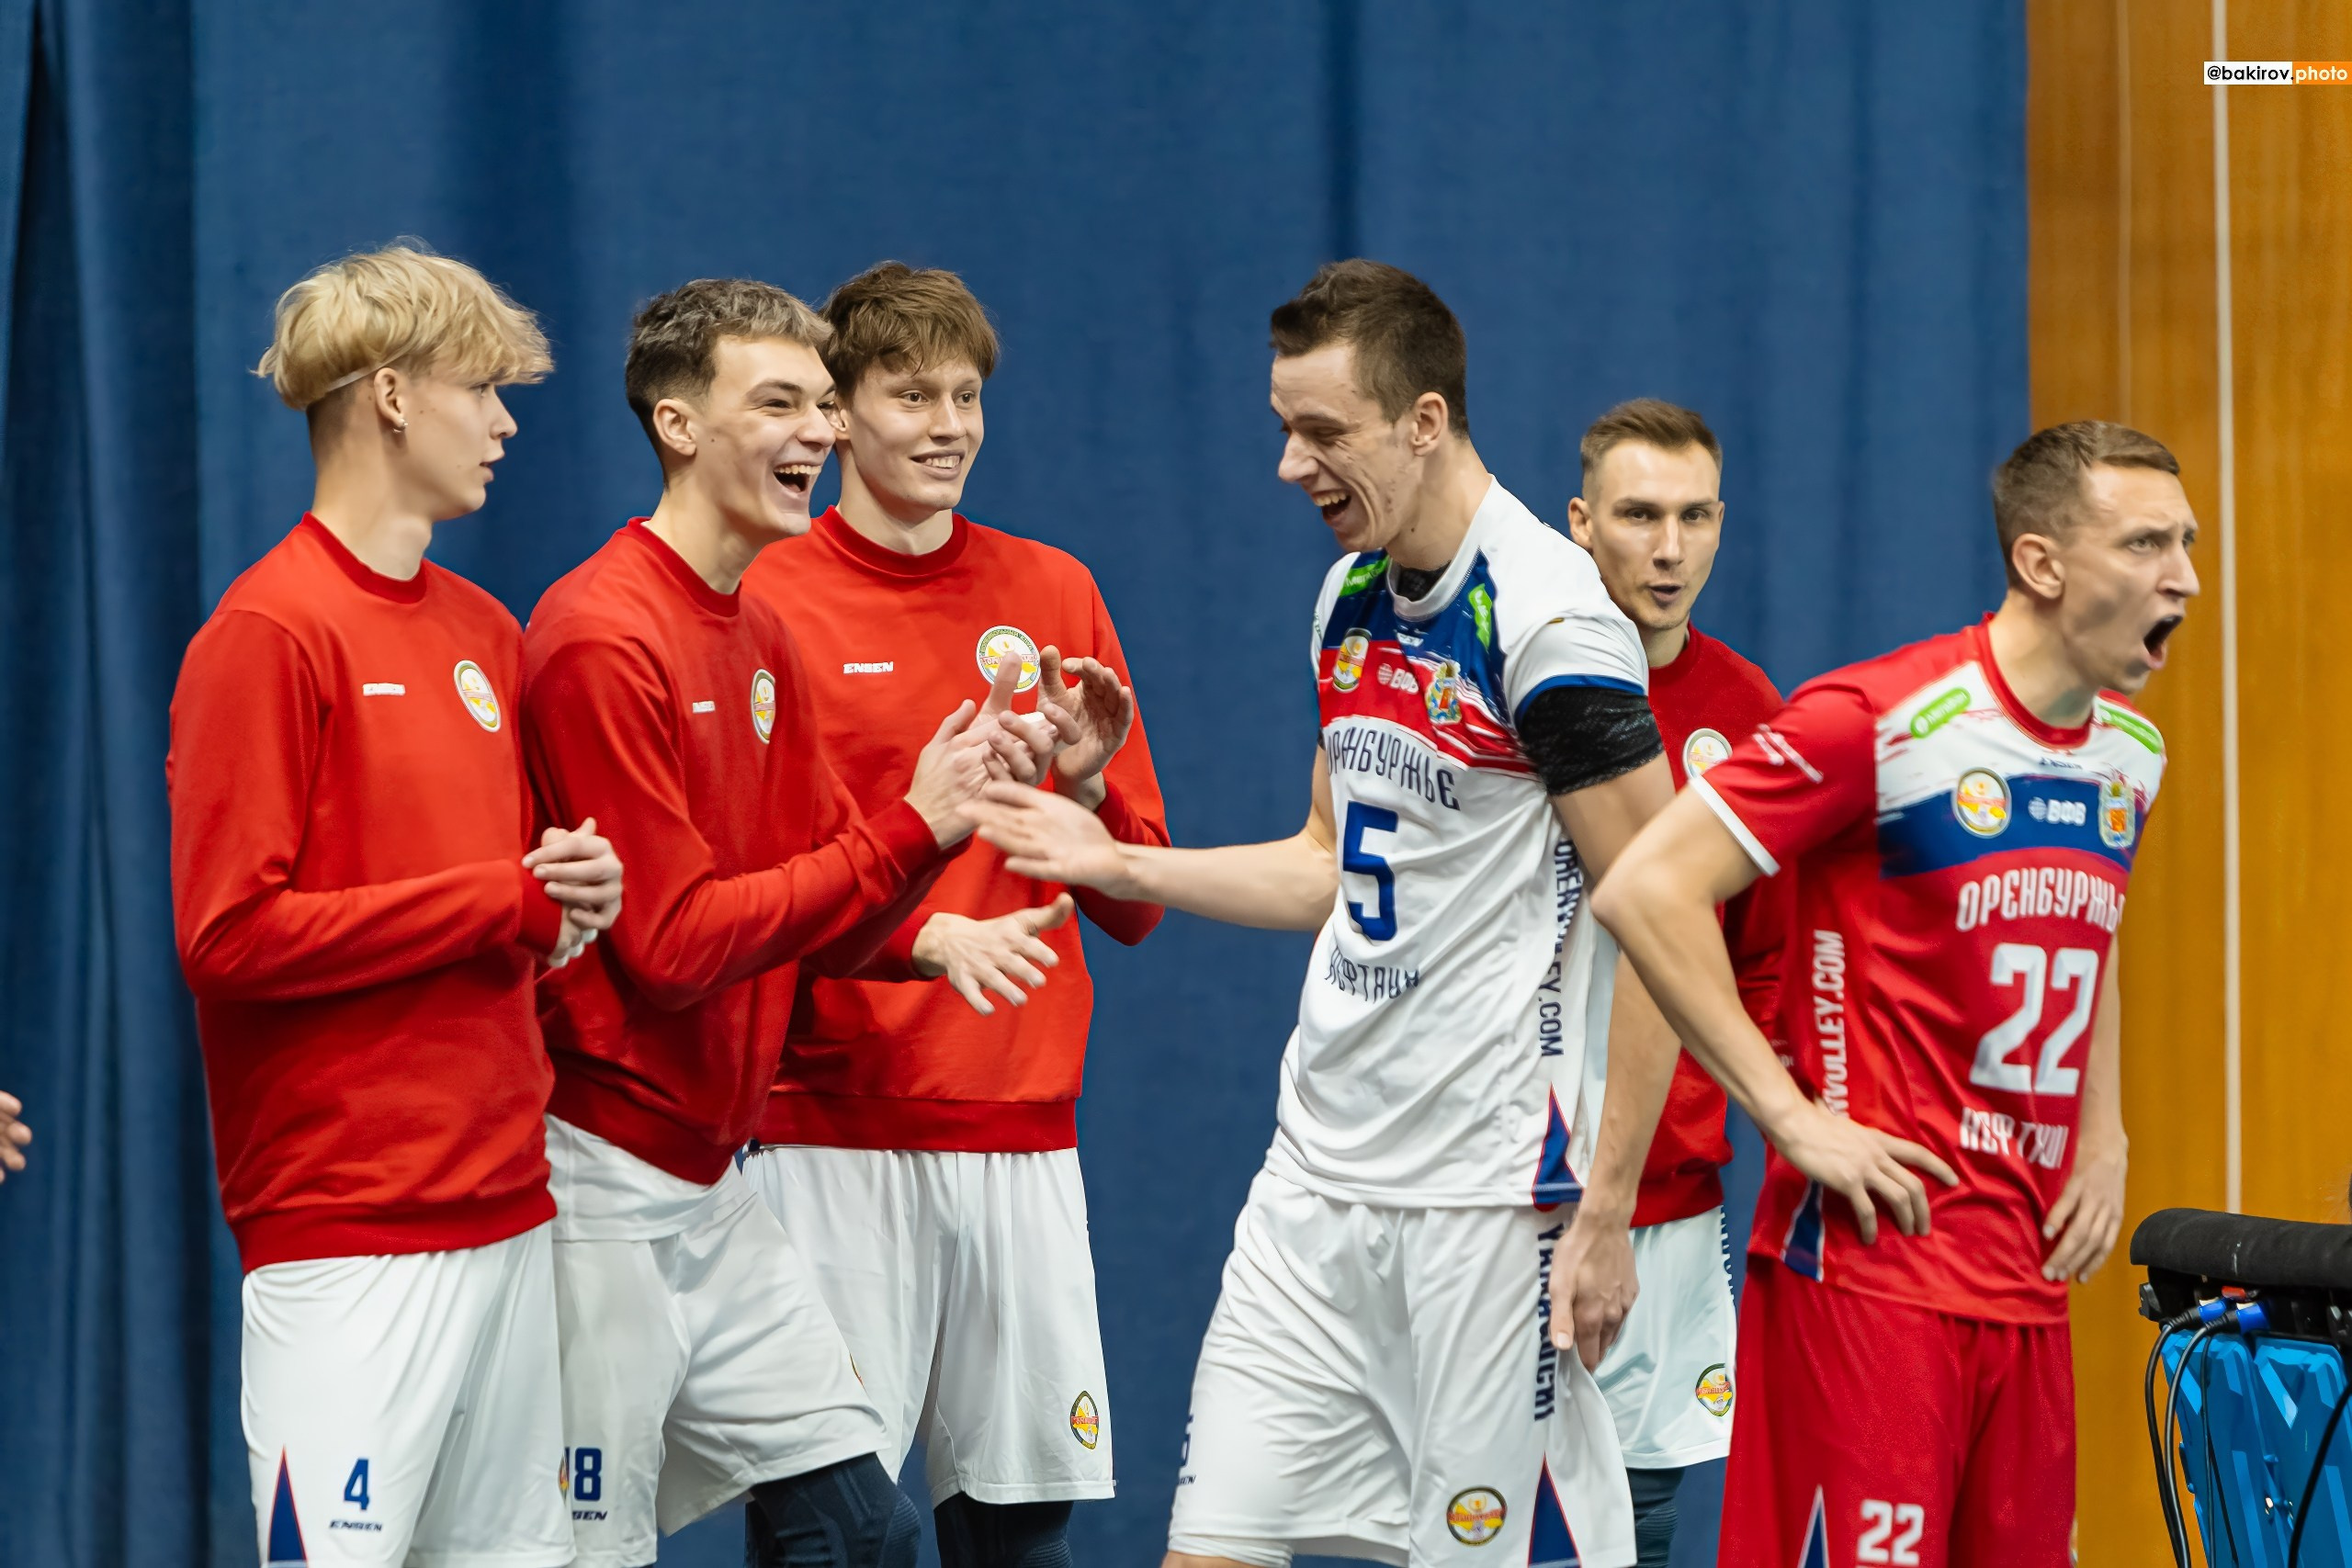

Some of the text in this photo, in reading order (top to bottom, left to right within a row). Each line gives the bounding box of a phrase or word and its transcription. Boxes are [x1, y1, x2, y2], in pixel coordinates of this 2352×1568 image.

[1342, 800, 1398, 942] 5
[1969, 942, 2098, 1097] 22
[344, 1458, 370, 1511] 4
[1857, 1498, 1925, 1567] 22
